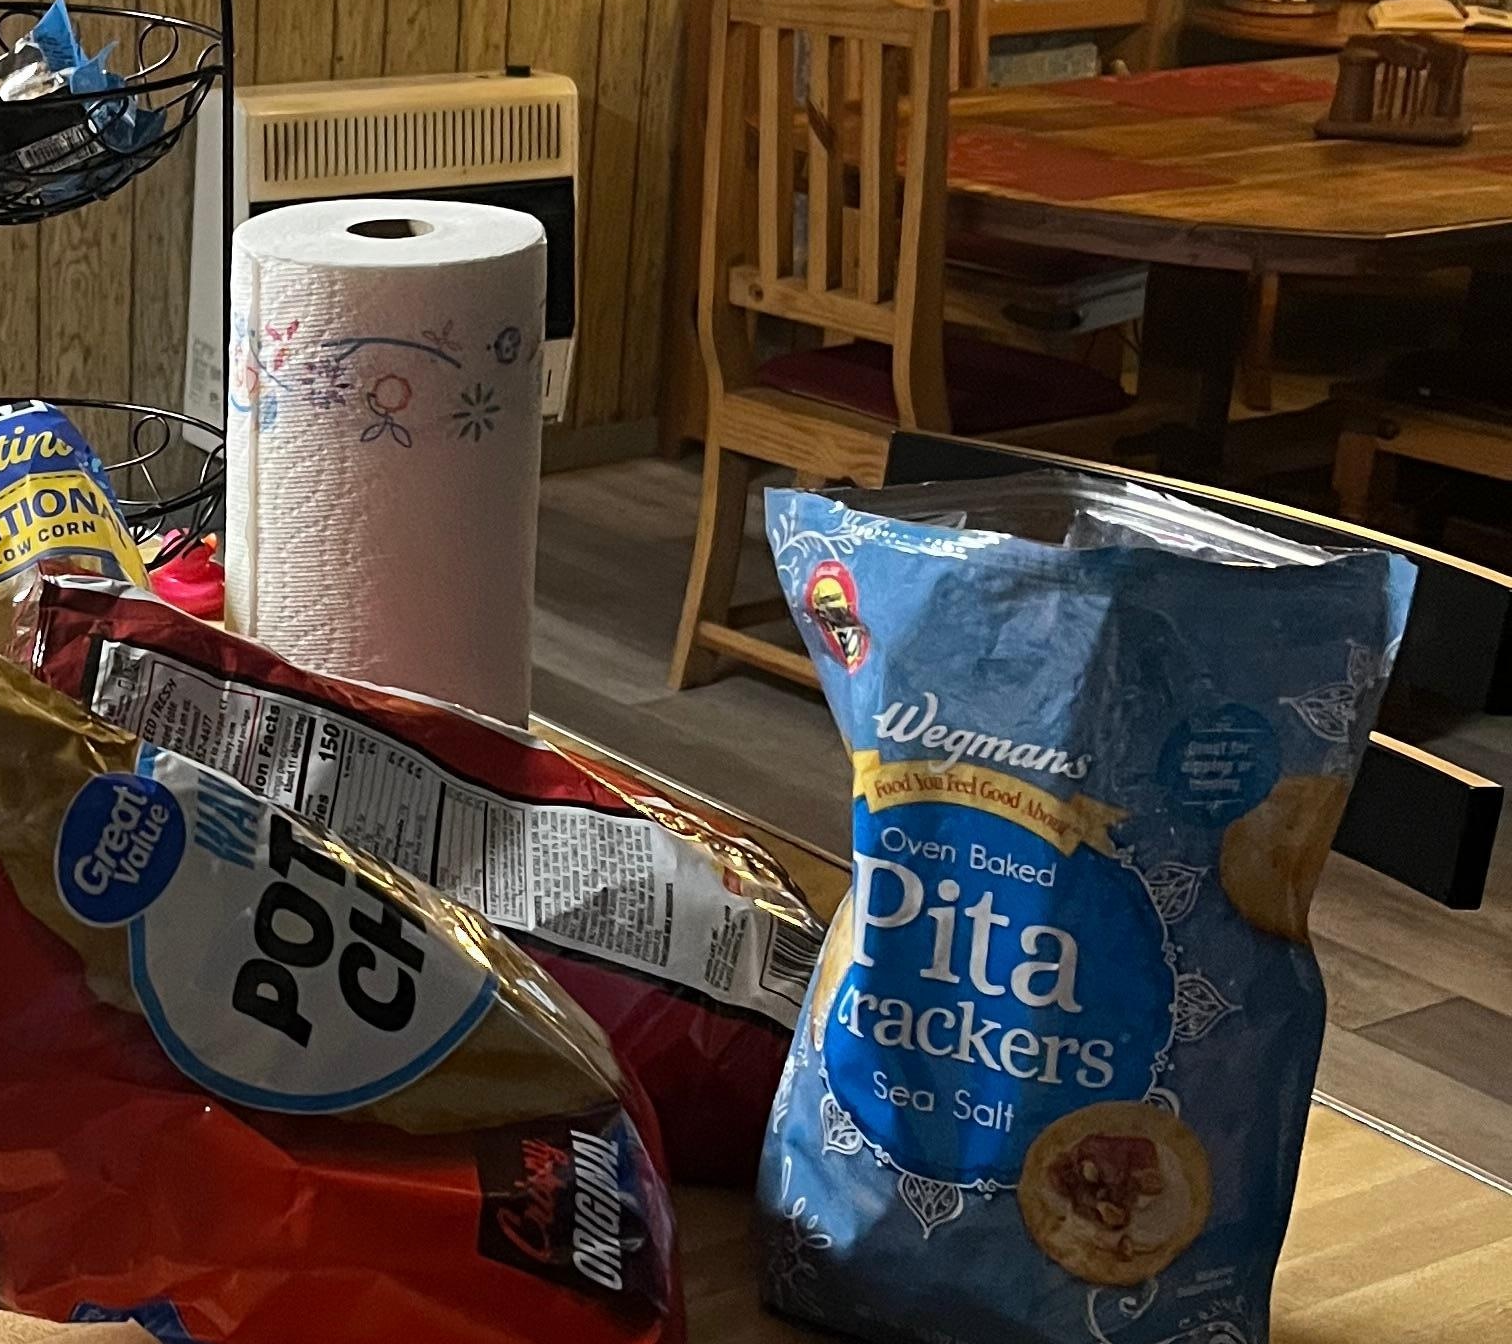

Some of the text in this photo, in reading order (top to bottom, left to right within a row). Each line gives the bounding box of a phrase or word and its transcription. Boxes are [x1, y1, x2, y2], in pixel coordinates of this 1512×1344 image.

[37, 519, 96, 543] CORN
[259, 704, 282, 757] Facts
[316, 722, 342, 763] 150
[872, 691, 1092, 780] Wegmans
[874, 772, 911, 799] Food
[913, 772, 945, 792] You
[946, 773, 977, 796] Feel
[979, 780, 1023, 810] Good
[74, 785, 148, 897] Great
[114, 803, 171, 886] Value
[880, 826, 1057, 888] Oven Baked
[852, 850, 1083, 1014] Pita
[871, 1069, 1015, 1133] Sea Salt
[569, 1128, 623, 1291] ORIGINAL
